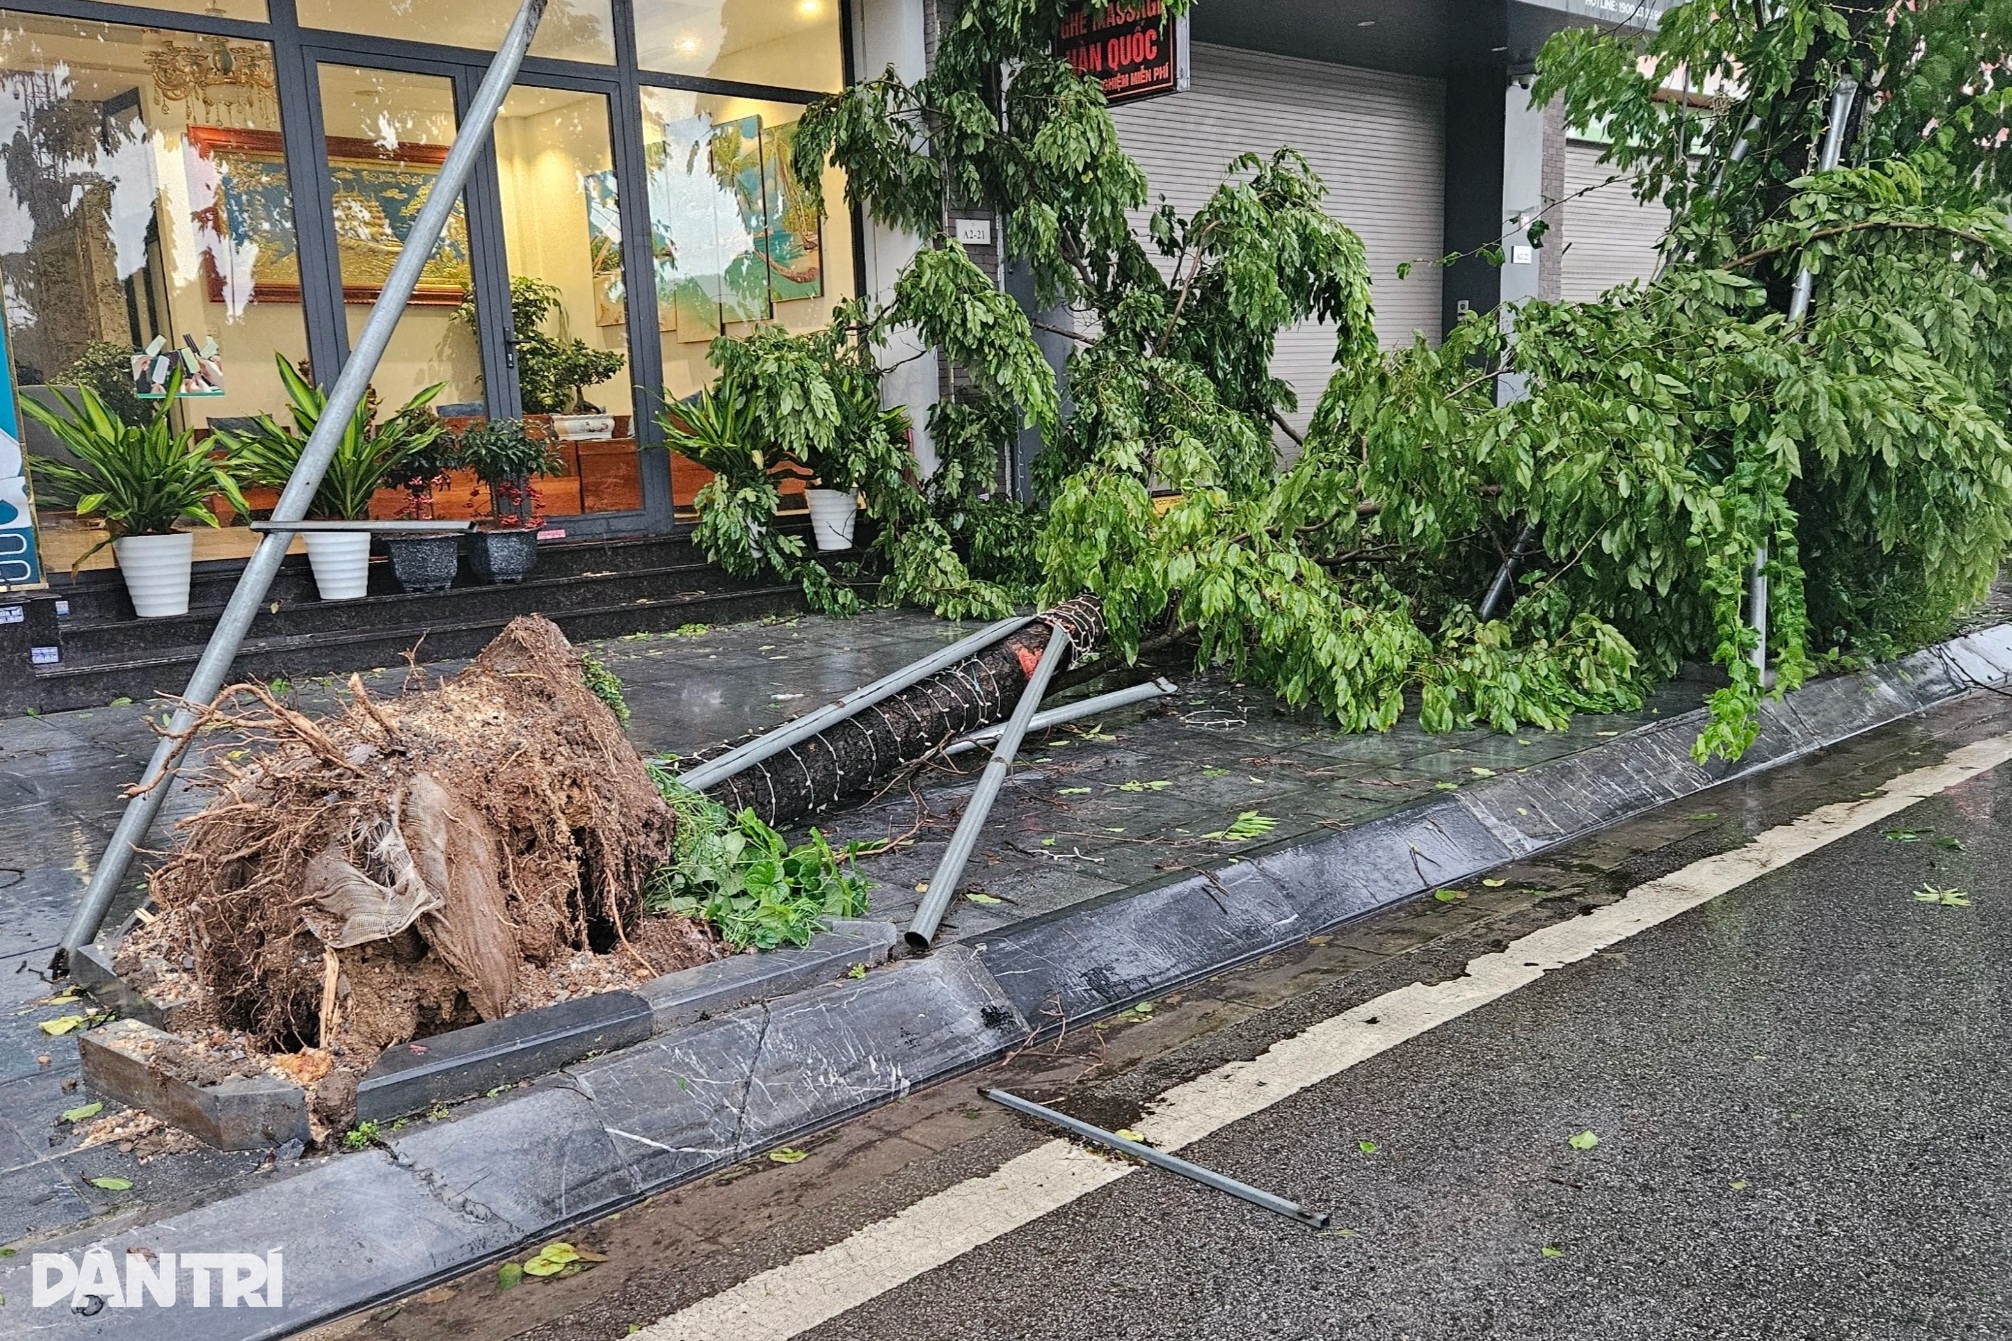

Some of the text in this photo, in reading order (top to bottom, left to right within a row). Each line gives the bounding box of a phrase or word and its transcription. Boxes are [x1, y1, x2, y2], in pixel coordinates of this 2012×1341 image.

[1107, 20, 1158, 71] QUỐC
[1102, 72, 1130, 92] GHIỆM
[1153, 62, 1169, 81] PHÍ
[963, 229, 985, 240] A2-21
